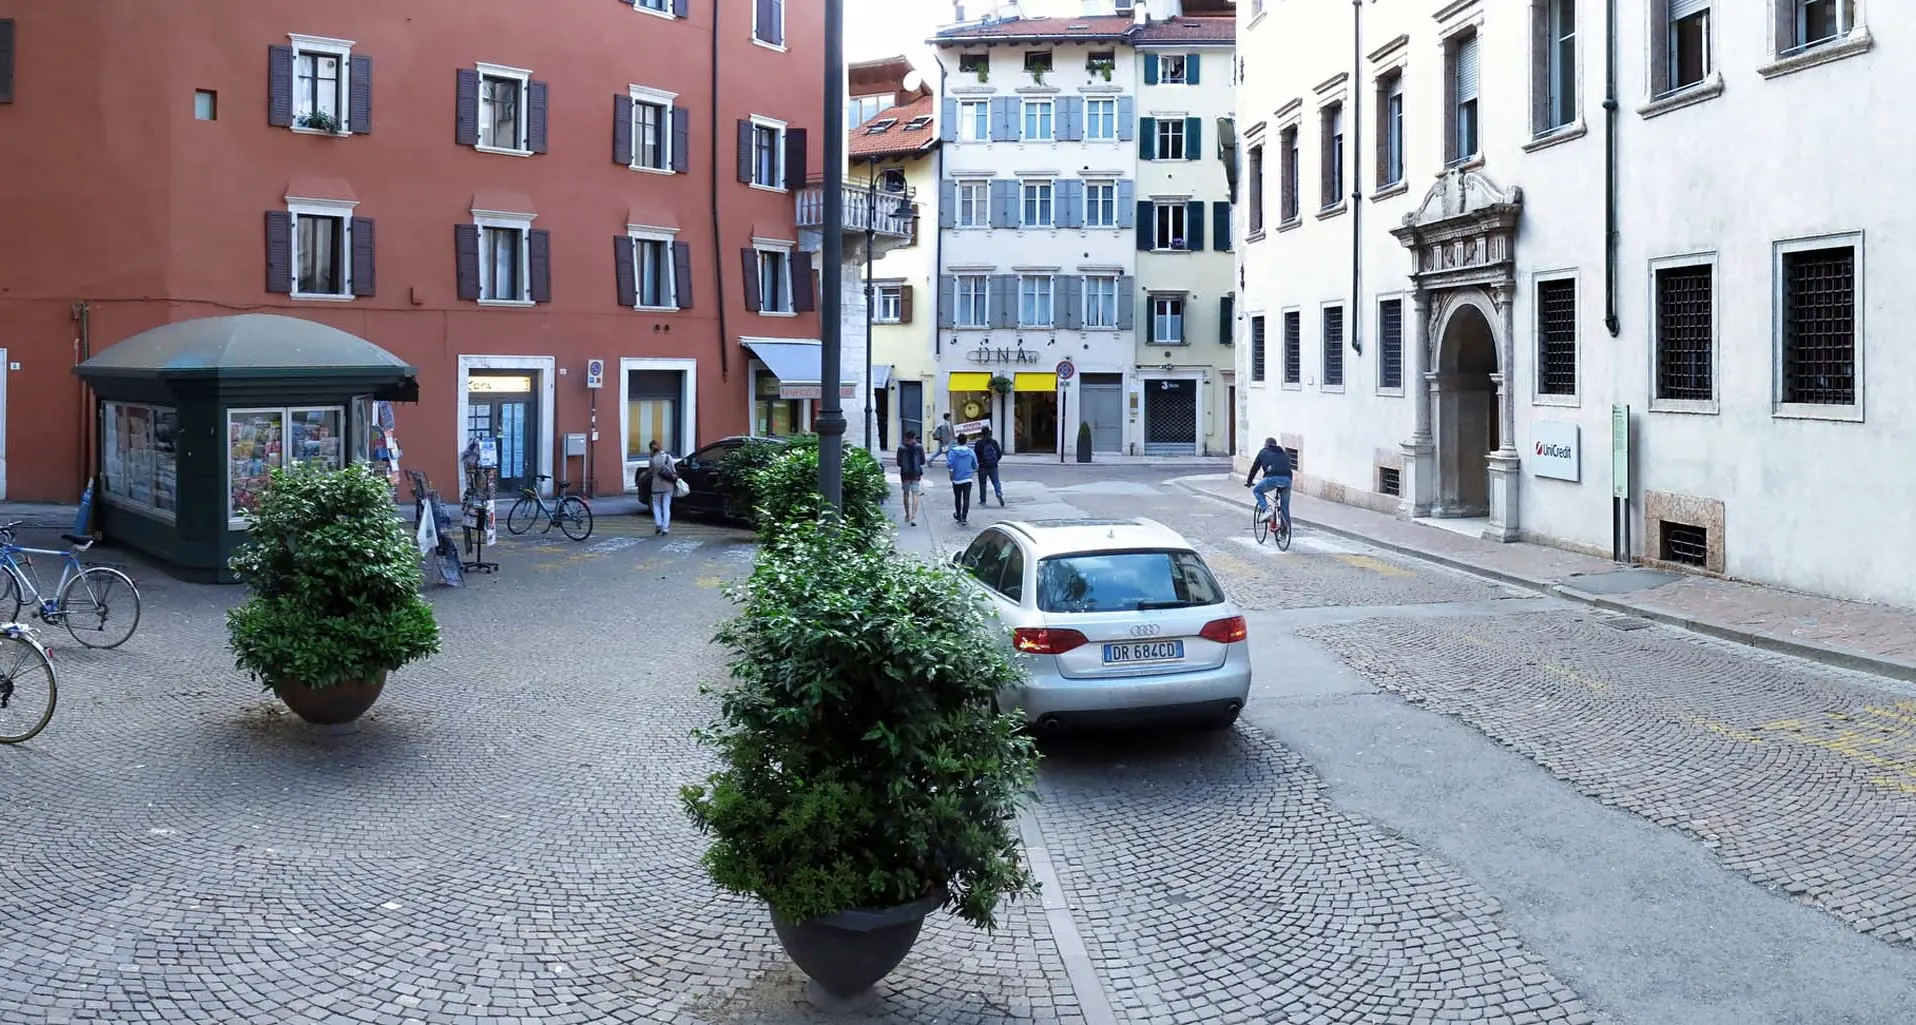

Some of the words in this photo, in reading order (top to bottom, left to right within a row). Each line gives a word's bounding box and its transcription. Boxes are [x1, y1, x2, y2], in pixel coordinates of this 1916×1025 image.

[1543, 443, 1571, 459] UniCredit
[1113, 645, 1130, 660] DR
[1134, 643, 1175, 659] 684CD
